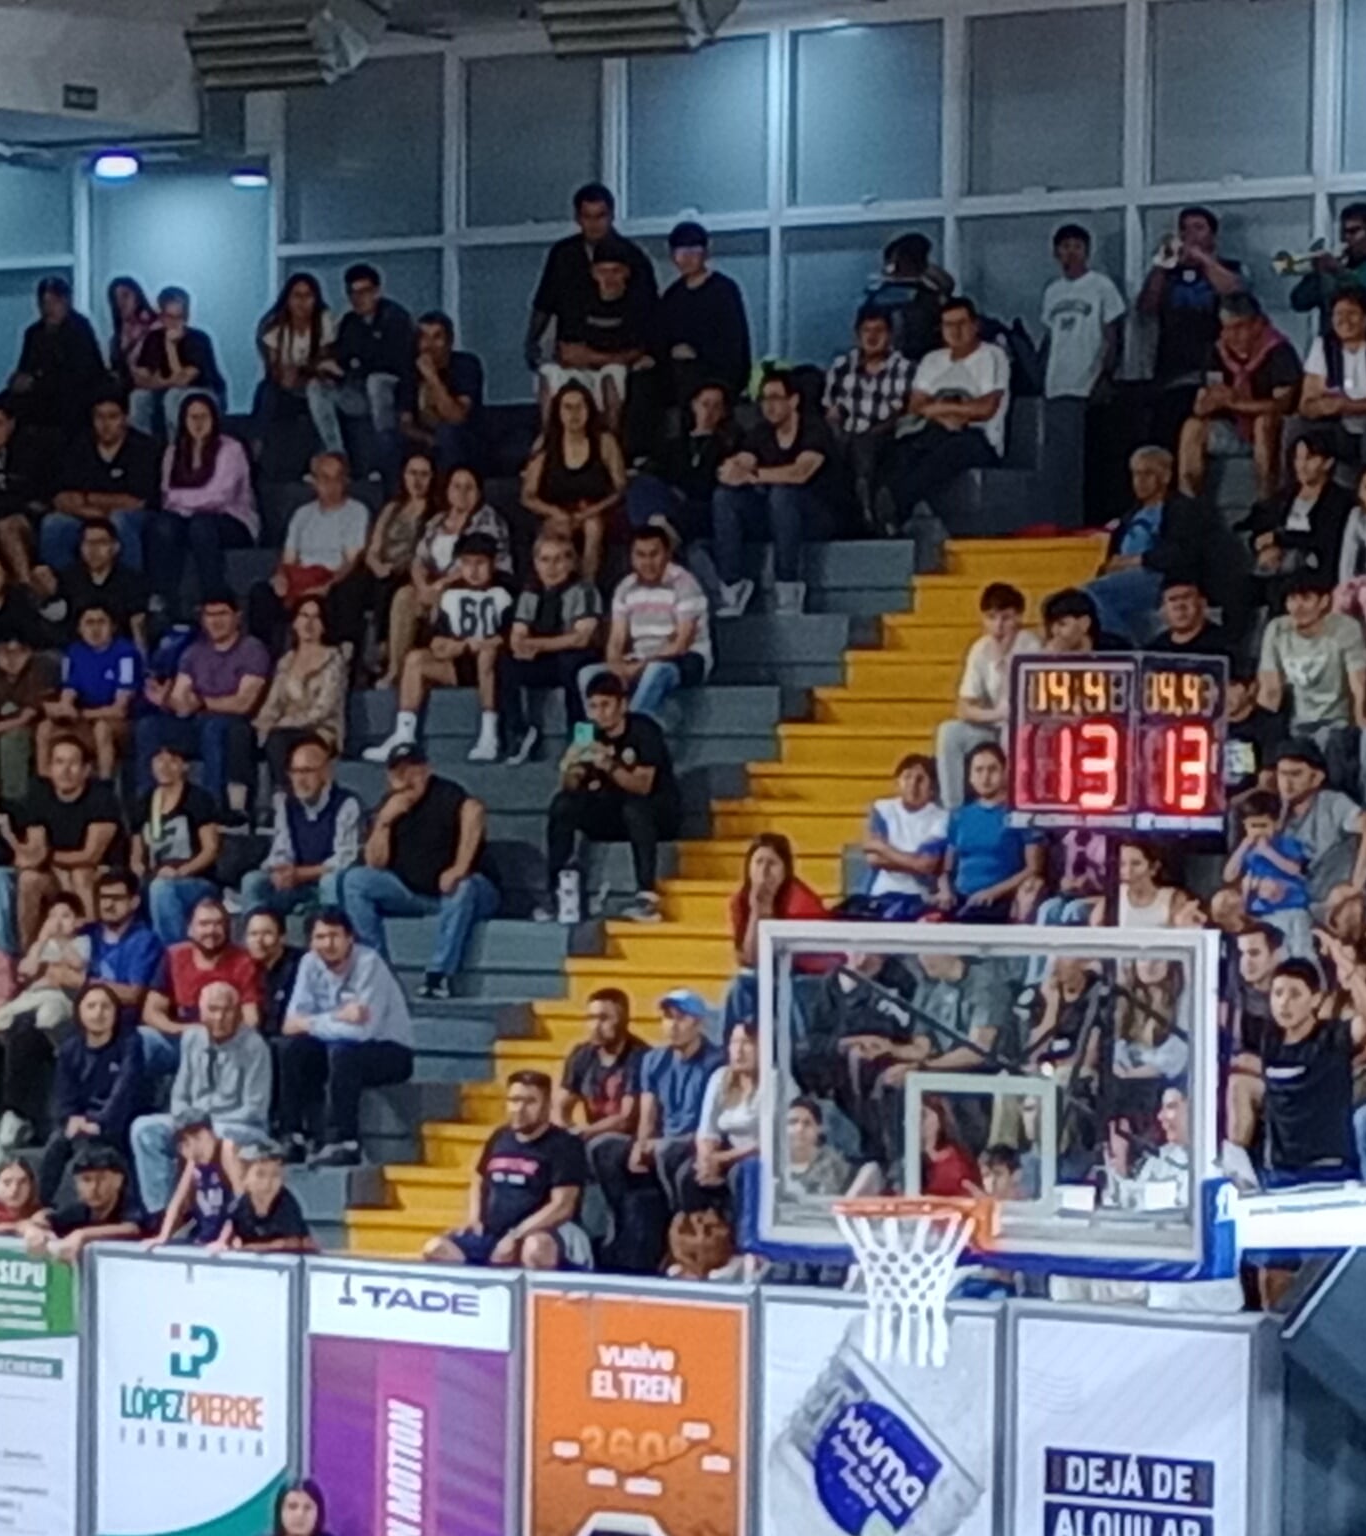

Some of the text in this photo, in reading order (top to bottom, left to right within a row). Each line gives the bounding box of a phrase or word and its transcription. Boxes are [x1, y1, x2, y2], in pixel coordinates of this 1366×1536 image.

[1059, 722, 1208, 810] 13 13
[590, 1368, 684, 1405] EL TREN
[386, 1398, 424, 1522] MOTION
[1064, 1454, 1194, 1502] DEJÁ DE
